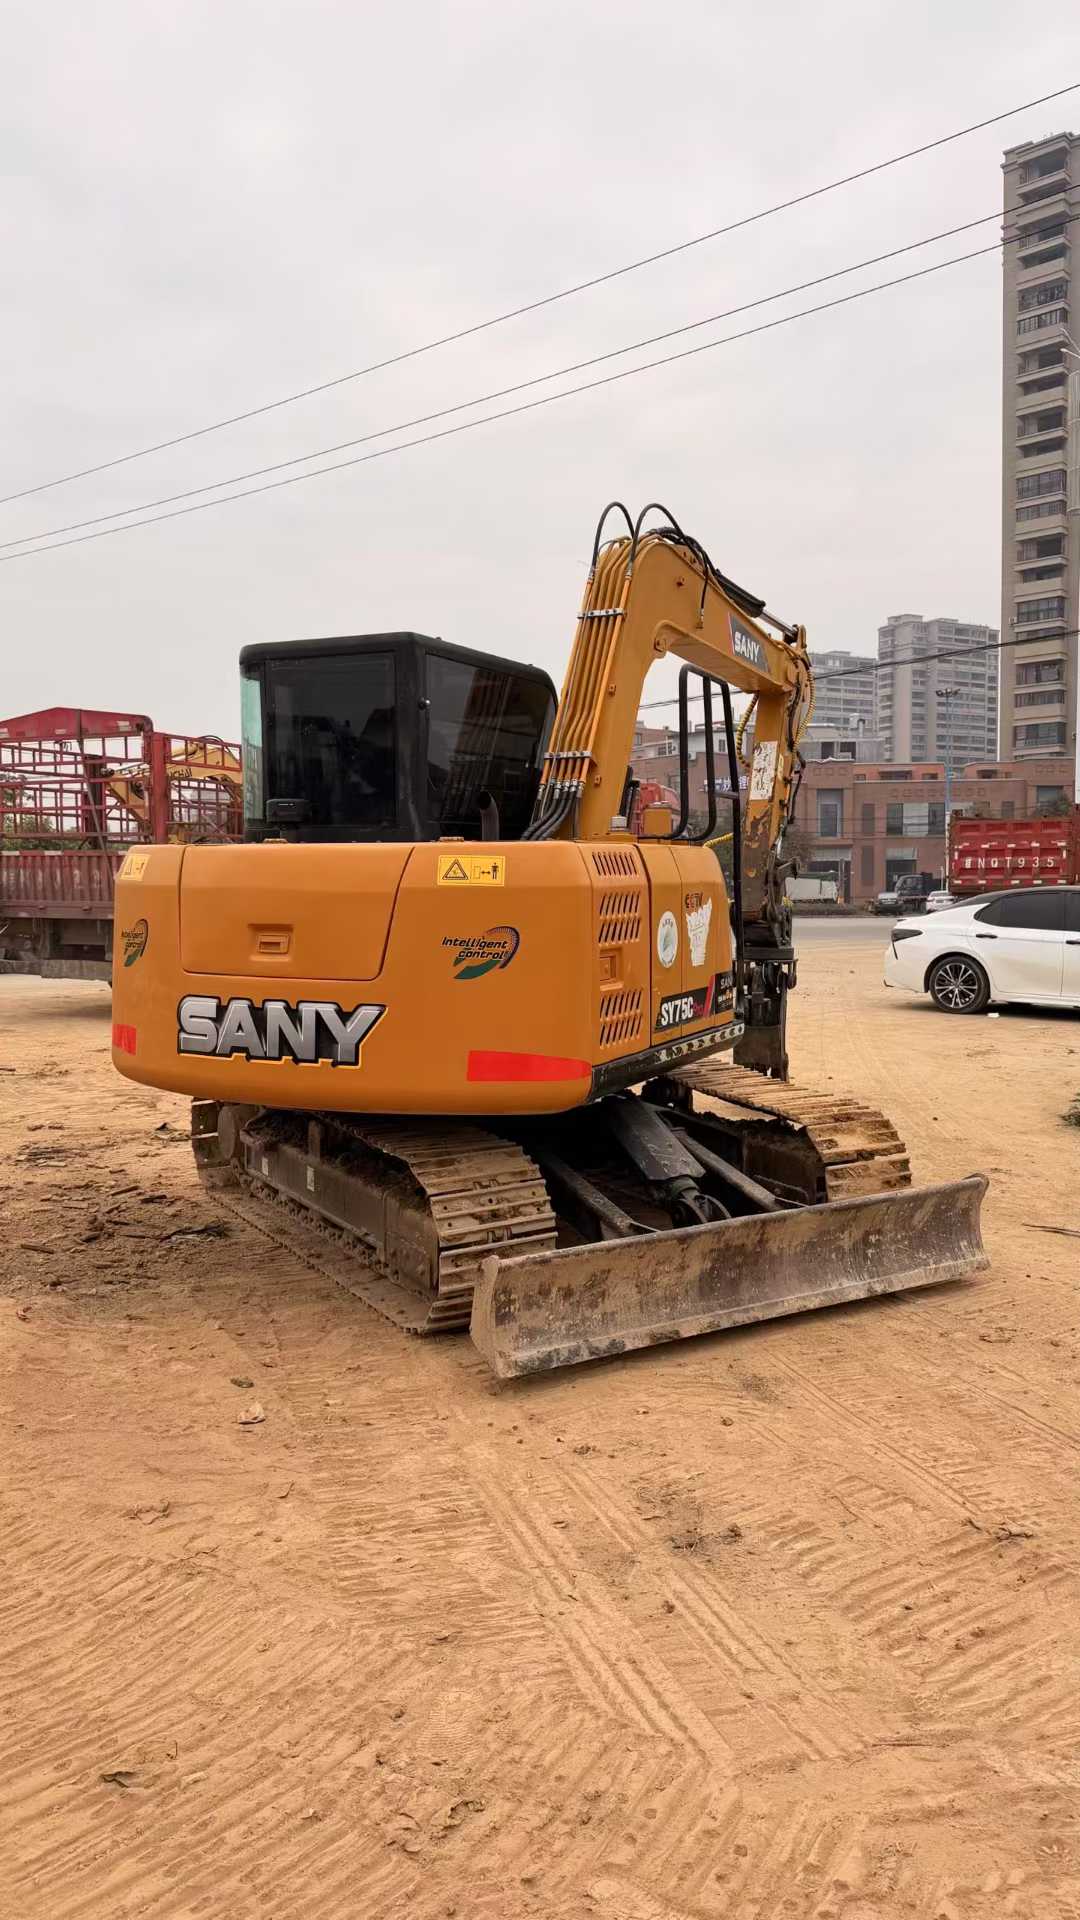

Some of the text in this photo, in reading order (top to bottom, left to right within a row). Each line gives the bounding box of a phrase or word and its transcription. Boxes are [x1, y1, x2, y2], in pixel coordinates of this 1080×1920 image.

[734, 631, 760, 663] SANY
[442, 937, 507, 950] Intelligent
[458, 950, 504, 960] control
[720, 975, 733, 989] SAN
[661, 997, 693, 1026] SY75C
[178, 995, 387, 1066] SANY
